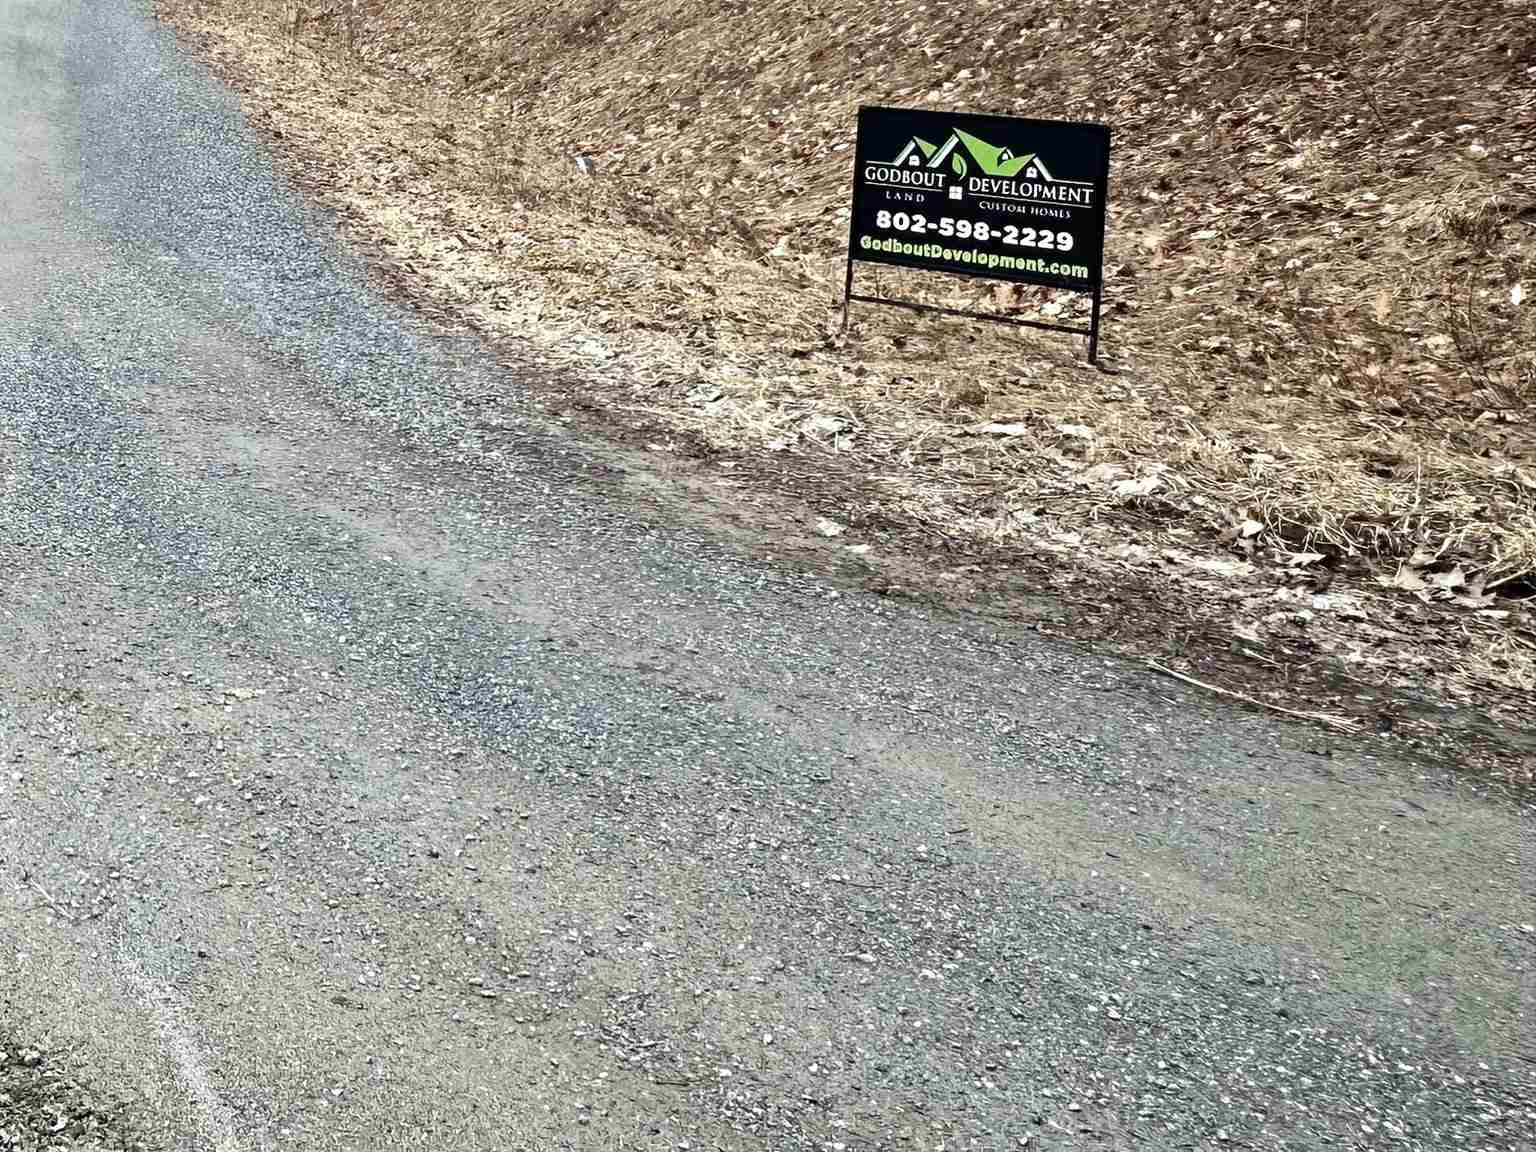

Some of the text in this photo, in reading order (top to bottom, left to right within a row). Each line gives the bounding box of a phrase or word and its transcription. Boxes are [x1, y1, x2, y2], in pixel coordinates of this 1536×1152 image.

[864, 166, 1094, 204] GODBOUT DEVELOPMENT
[885, 191, 1072, 219] LAND CUSTOM HOMES
[876, 210, 1074, 252] 802-598-2229
[860, 235, 1089, 279] GodboutDevelopment.com
